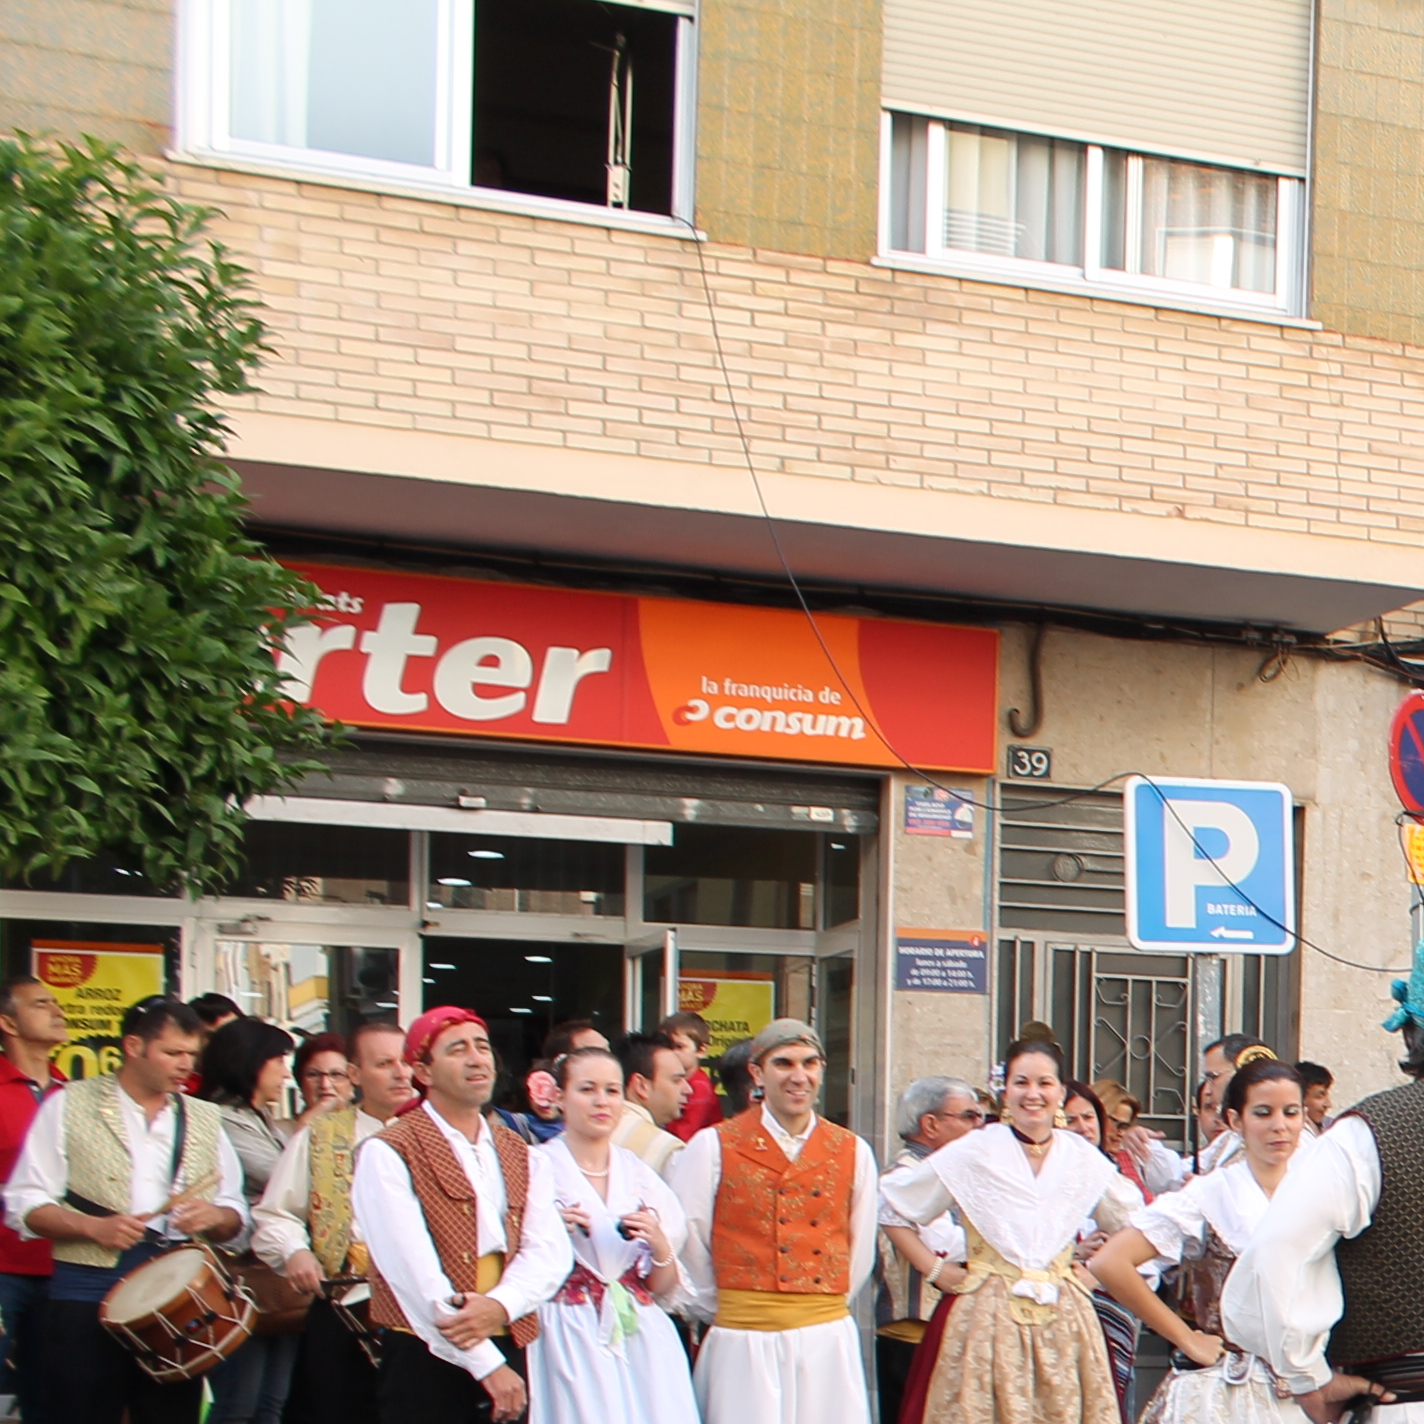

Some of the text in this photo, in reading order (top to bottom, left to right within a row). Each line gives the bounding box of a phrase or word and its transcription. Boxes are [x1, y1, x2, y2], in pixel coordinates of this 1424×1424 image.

[276, 602, 613, 724] rter
[701, 676, 842, 706] la franquicia de
[712, 705, 867, 740] consum
[1013, 751, 1049, 777] 39
[1163, 799, 1261, 929] P
[1207, 903, 1258, 917] BATERIA
[76, 987, 122, 1001] ARROZ
